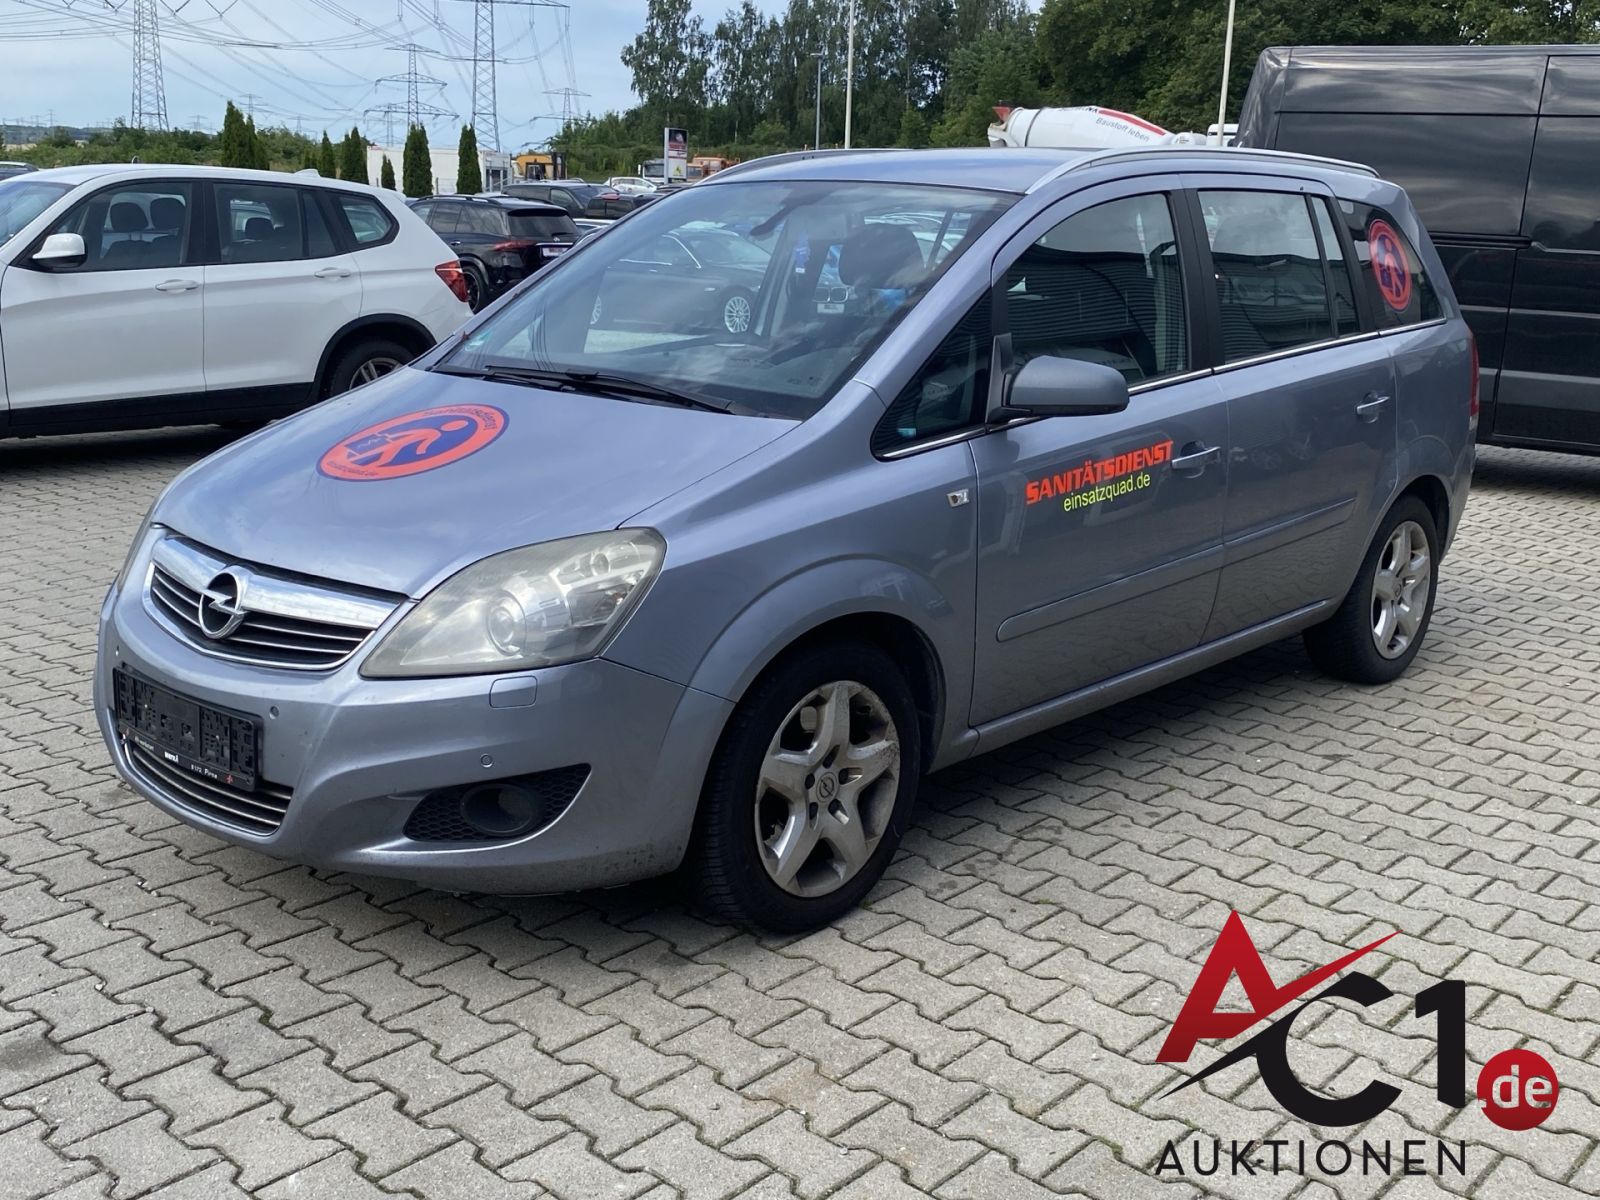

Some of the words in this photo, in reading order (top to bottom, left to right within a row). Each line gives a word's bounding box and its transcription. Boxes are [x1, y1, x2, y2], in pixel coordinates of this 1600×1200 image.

[1095, 117, 1128, 132] Baustoff
[1128, 127, 1150, 142] leben
[1025, 440, 1174, 504] SANITÄTSDIENST
[1063, 471, 1152, 513] einsatzquad.de
